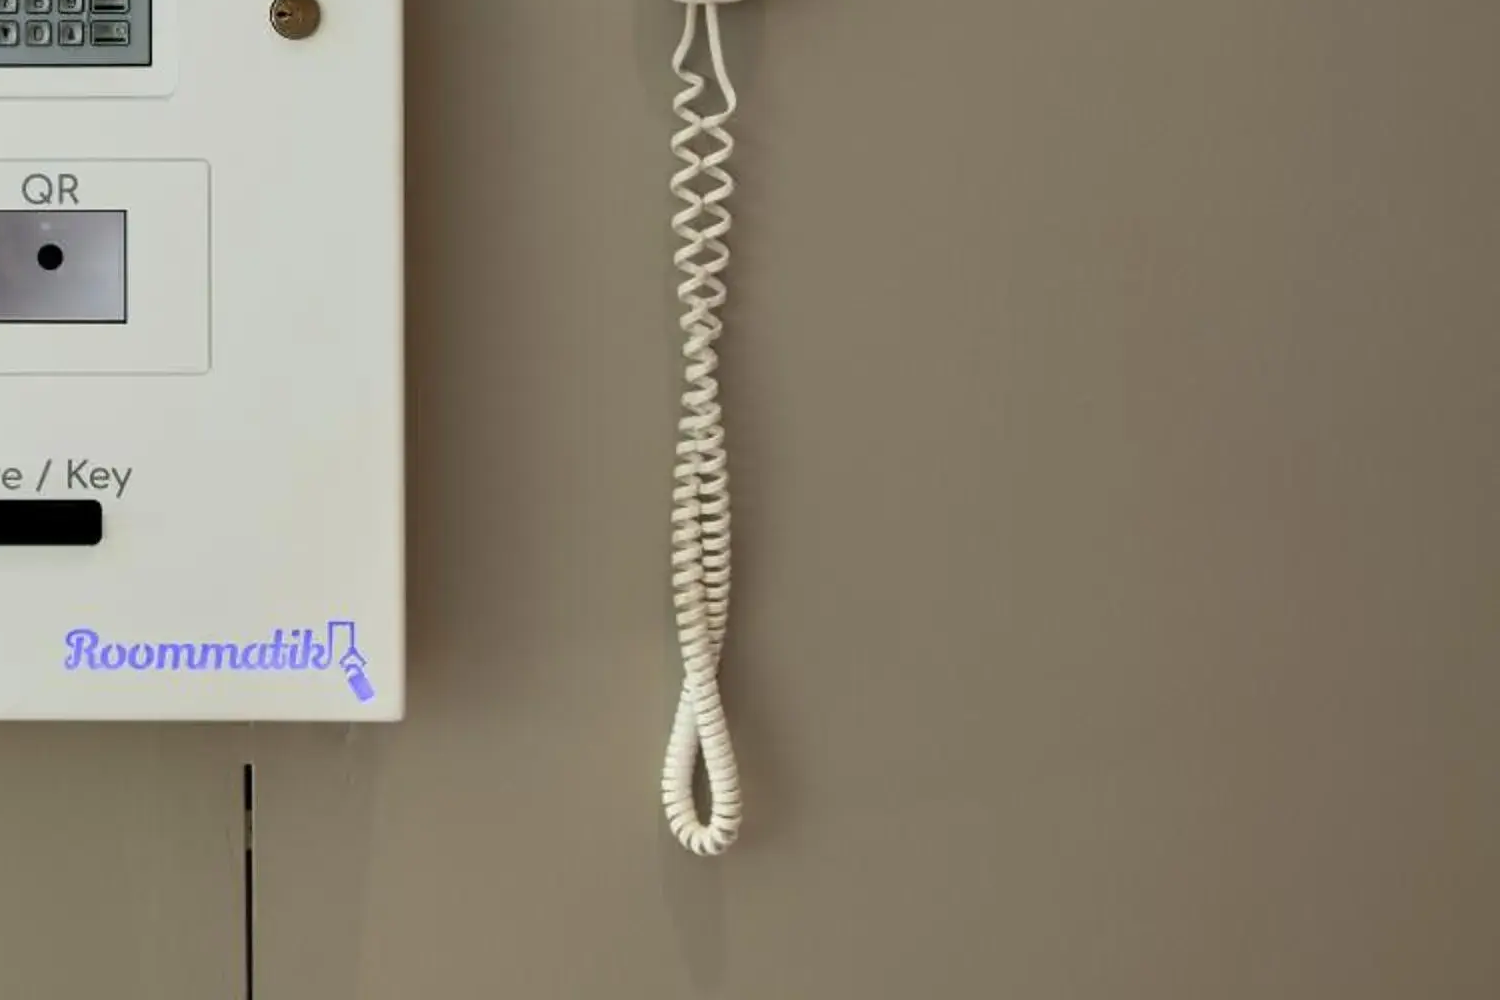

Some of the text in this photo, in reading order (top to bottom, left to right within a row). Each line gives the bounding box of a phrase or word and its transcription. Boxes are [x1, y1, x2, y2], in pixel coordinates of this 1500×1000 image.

[21, 173, 80, 205] QR
[35, 458, 53, 493] /
[67, 459, 133, 499] Key
[64, 628, 332, 671] Roommatik
